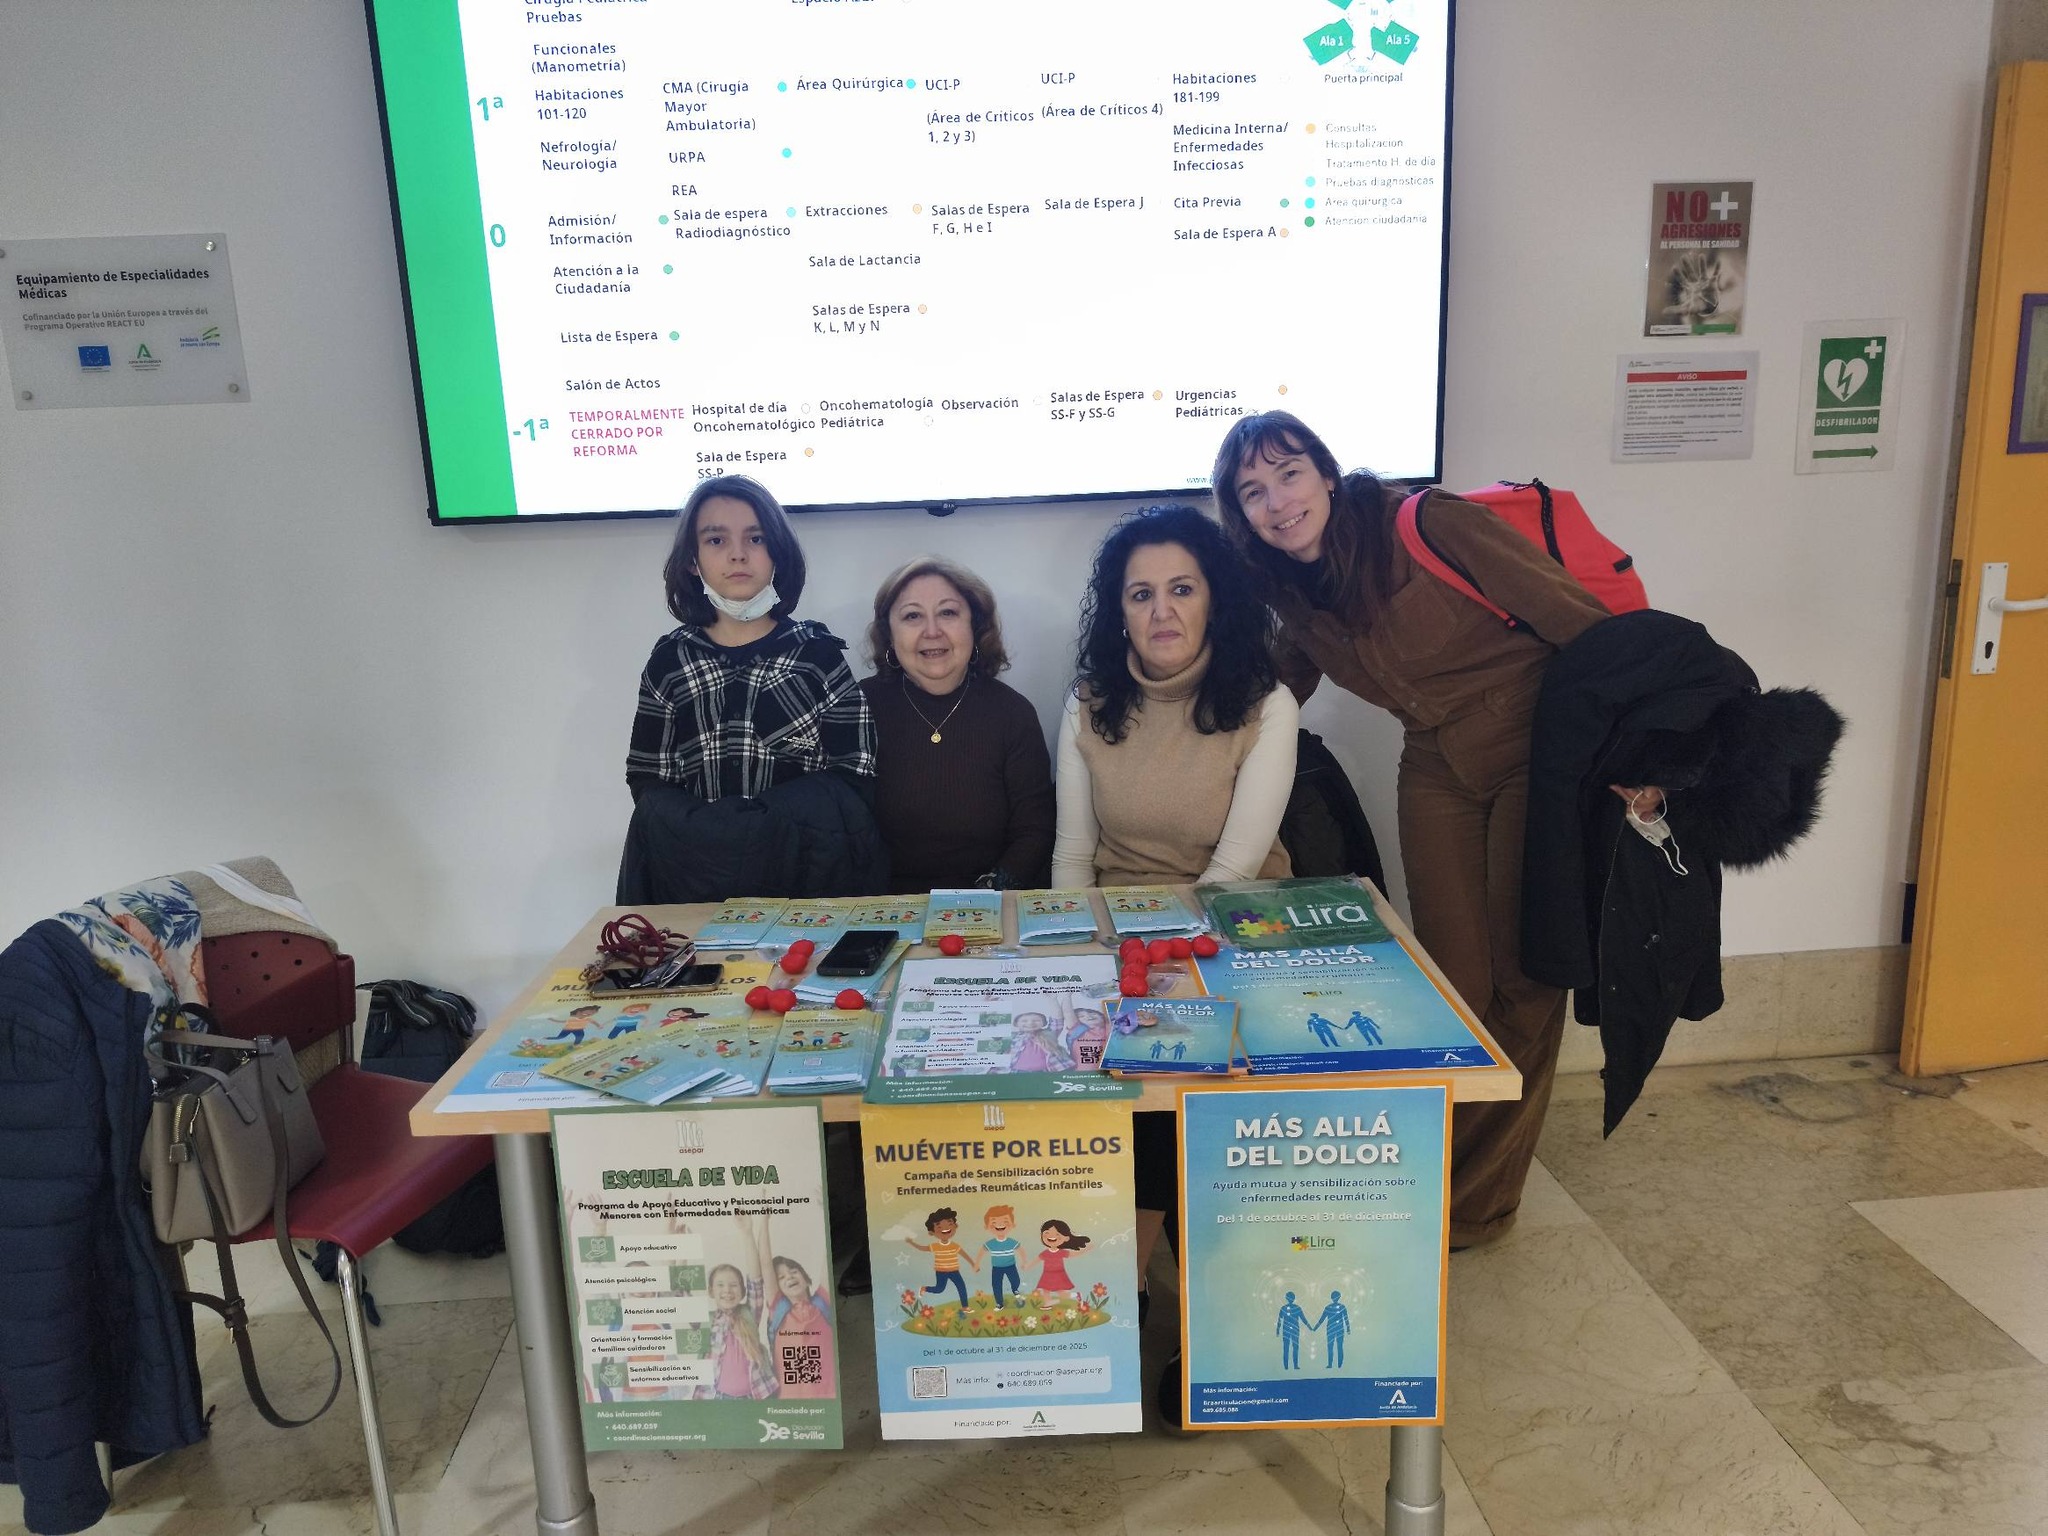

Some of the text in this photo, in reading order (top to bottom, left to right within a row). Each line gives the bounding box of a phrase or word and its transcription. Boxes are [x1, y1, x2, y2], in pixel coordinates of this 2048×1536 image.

[526, 11, 582, 23] Pruebas
[533, 42, 616, 55] Funcionales
[531, 59, 626, 74] (Manometría)
[797, 76, 904, 93] Área Quirúrgica
[925, 78, 960, 91] UCI-P
[1041, 72, 1075, 84] UCI-P
[1173, 72, 1256, 84] Habitaciones
[535, 88, 624, 101] Habitaciones
[663, 80, 749, 96] CMA (Cirugía
[1173, 91, 1220, 103] 181-199
[476, 96, 504, 121] 1ª
[537, 107, 587, 120] 101-120
[664, 101, 707, 116] Mayor
[1042, 103, 1163, 118] (Área de Críticos 4)
[666, 118, 756, 131] Ambulatoria)
[1173, 122, 1289, 135] Medicina Interna/
[540, 139, 617, 155] Nefrología/
[1174, 140, 1264, 153] Enfermedades
[669, 151, 706, 163] URPA
[542, 157, 617, 173] Neurología
[1173, 159, 1244, 171] Infecciosas
[672, 184, 697, 196] REA
[1174, 196, 1241, 208] Cita Previa
[674, 209, 768, 222] Sala de espera
[806, 204, 888, 217] Extracciones
[931, 203, 1030, 217] Salas de Espera
[548, 214, 616, 227] Admisión/
[490, 223, 507, 248] 0
[676, 225, 791, 241] Radiodiagnóstico
[1660, 223, 1741, 239] AGRESIONES
[550, 232, 632, 245] Información
[809, 253, 921, 267] Sala de Lactancia
[553, 264, 639, 278] Atención a la
[16, 268, 209, 288] Equipamiento de Especialidades
[18, 287, 67, 299] Médicas
[555, 281, 631, 294] Ciudadanía
[22, 312, 76, 322] Cofinanciado
[77, 313, 91, 321] por
[101, 309, 126, 318] Unión
[127, 309, 161, 319] Europea
[168, 307, 194, 316] través
[812, 303, 910, 317] Salas de Espera
[24, 323, 64, 332] Programa
[66, 320, 105, 330] Operativo
[107, 319, 132, 328] REACT
[561, 330, 658, 344] Lista de Espera
[1677, 373, 1698, 381] AVISO
[566, 378, 661, 391] Salón de Actos
[1176, 389, 1237, 403] Urgencias
[692, 401, 787, 418] Hospital de día
[820, 397, 933, 411] Oncohematología
[941, 397, 1019, 410] Observación
[569, 408, 684, 422] TEMPORALMENTE
[1175, 405, 1243, 418] Pediátricas
[693, 416, 815, 433] Oncohematológico
[821, 416, 884, 429] Pediátrica
[1816, 417, 1878, 427] DESFIBRILADOR
[513, 417, 550, 442] -1ª
[571, 426, 663, 440] CERRADO POR
[573, 445, 638, 457] REFORMA
[1286, 902, 1369, 927] Lira
[1231, 954, 1376, 969] DEL DOLOR
[933, 975, 1082, 986] ESCUELA DE VIDA
[1236, 1110, 1392, 1138] MÁS ALLÁ
[679, 1146, 704, 1154] asepar
[875, 1137, 1121, 1163] MUÉVETE POR ELLOS
[1227, 1143, 1399, 1167] DEL DOLOR
[602, 1165, 780, 1190] ESCUELA DE VIDA
[904, 1164, 1094, 1182] Campaña de Sensibilización sobre
[897, 1179, 1103, 1196] Enfermedades Reumáticas Infantiles
[1213, 1181, 1247, 1192] Ayuda
[1290, 1181, 1297, 1190] y
[1300, 1178, 1382, 1188] sensibilización
[1385, 1177, 1416, 1186] sobre
[578, 1196, 810, 1211] Programa de Apoyo Educativo y Psicosocial para
[1241, 1192, 1387, 1203] enfermedades reumáticas
[600, 1205, 790, 1220] Menores con Enfermedades Reumáticas
[1217, 1211, 1412, 1224] Del 1 de octubre al 31 de diciembre
[1310, 1236, 1335, 1248] Lira
[620, 1245, 642, 1253] Apoyo
[624, 1307, 655, 1315] Atención
[793, 1430, 825, 1440] Sevilla
